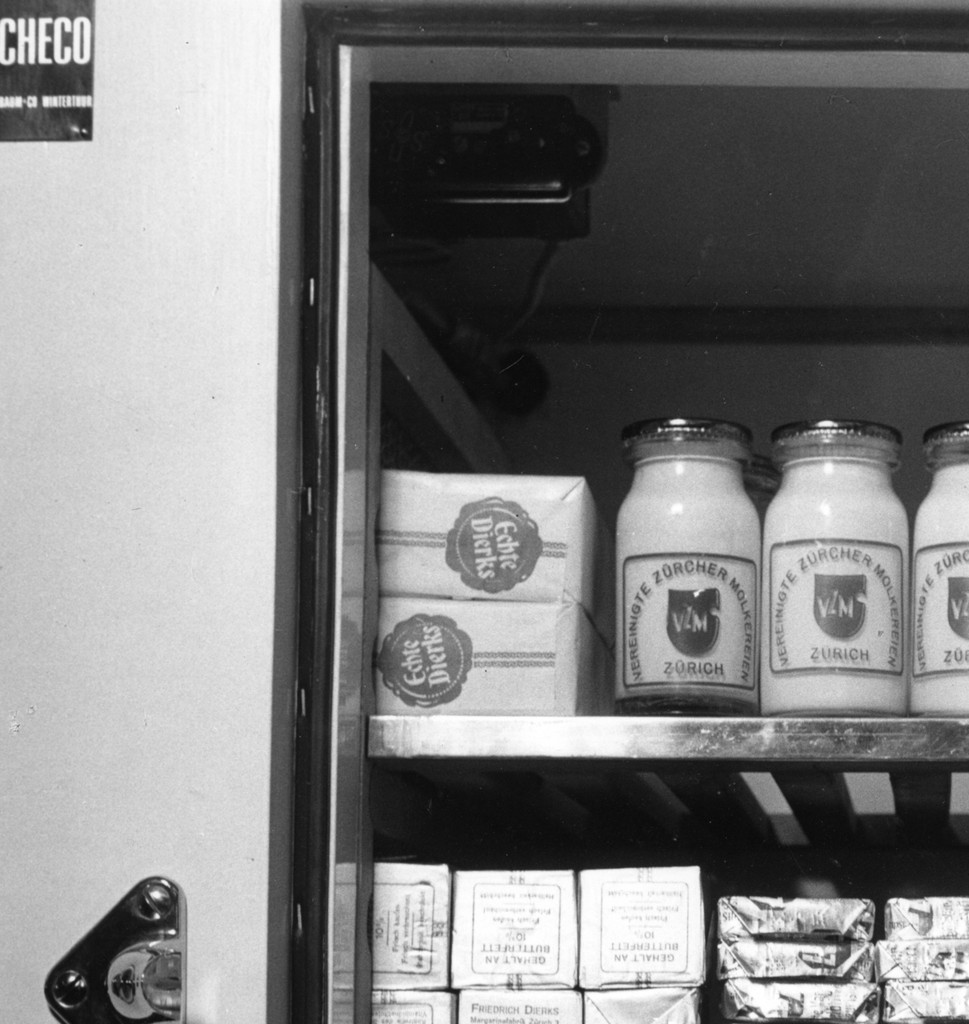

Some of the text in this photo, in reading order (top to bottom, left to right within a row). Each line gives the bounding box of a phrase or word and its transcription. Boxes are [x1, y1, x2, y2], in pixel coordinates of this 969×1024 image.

[471, 515, 498, 580] Dierks
[493, 520, 520, 571] Echte
[628, 582, 652, 682] VEREINIGTE
[729, 577, 753, 683] MOLKEREIEN
[775, 569, 797, 667] VEREINIGTE
[873, 563, 900, 668] MOLKEREIEN
[401, 639, 426, 686] Echte
[421, 624, 451, 688] Dierks
[481, 943, 551, 954] BUTTERFETT
[485, 955, 546, 965] GEHALT AN
[609, 942, 679, 952] BUTTERFETT
[613, 953, 675, 963] GEHALT AN
[471, 1003, 560, 1015] FRIEDRICH DIERKS
